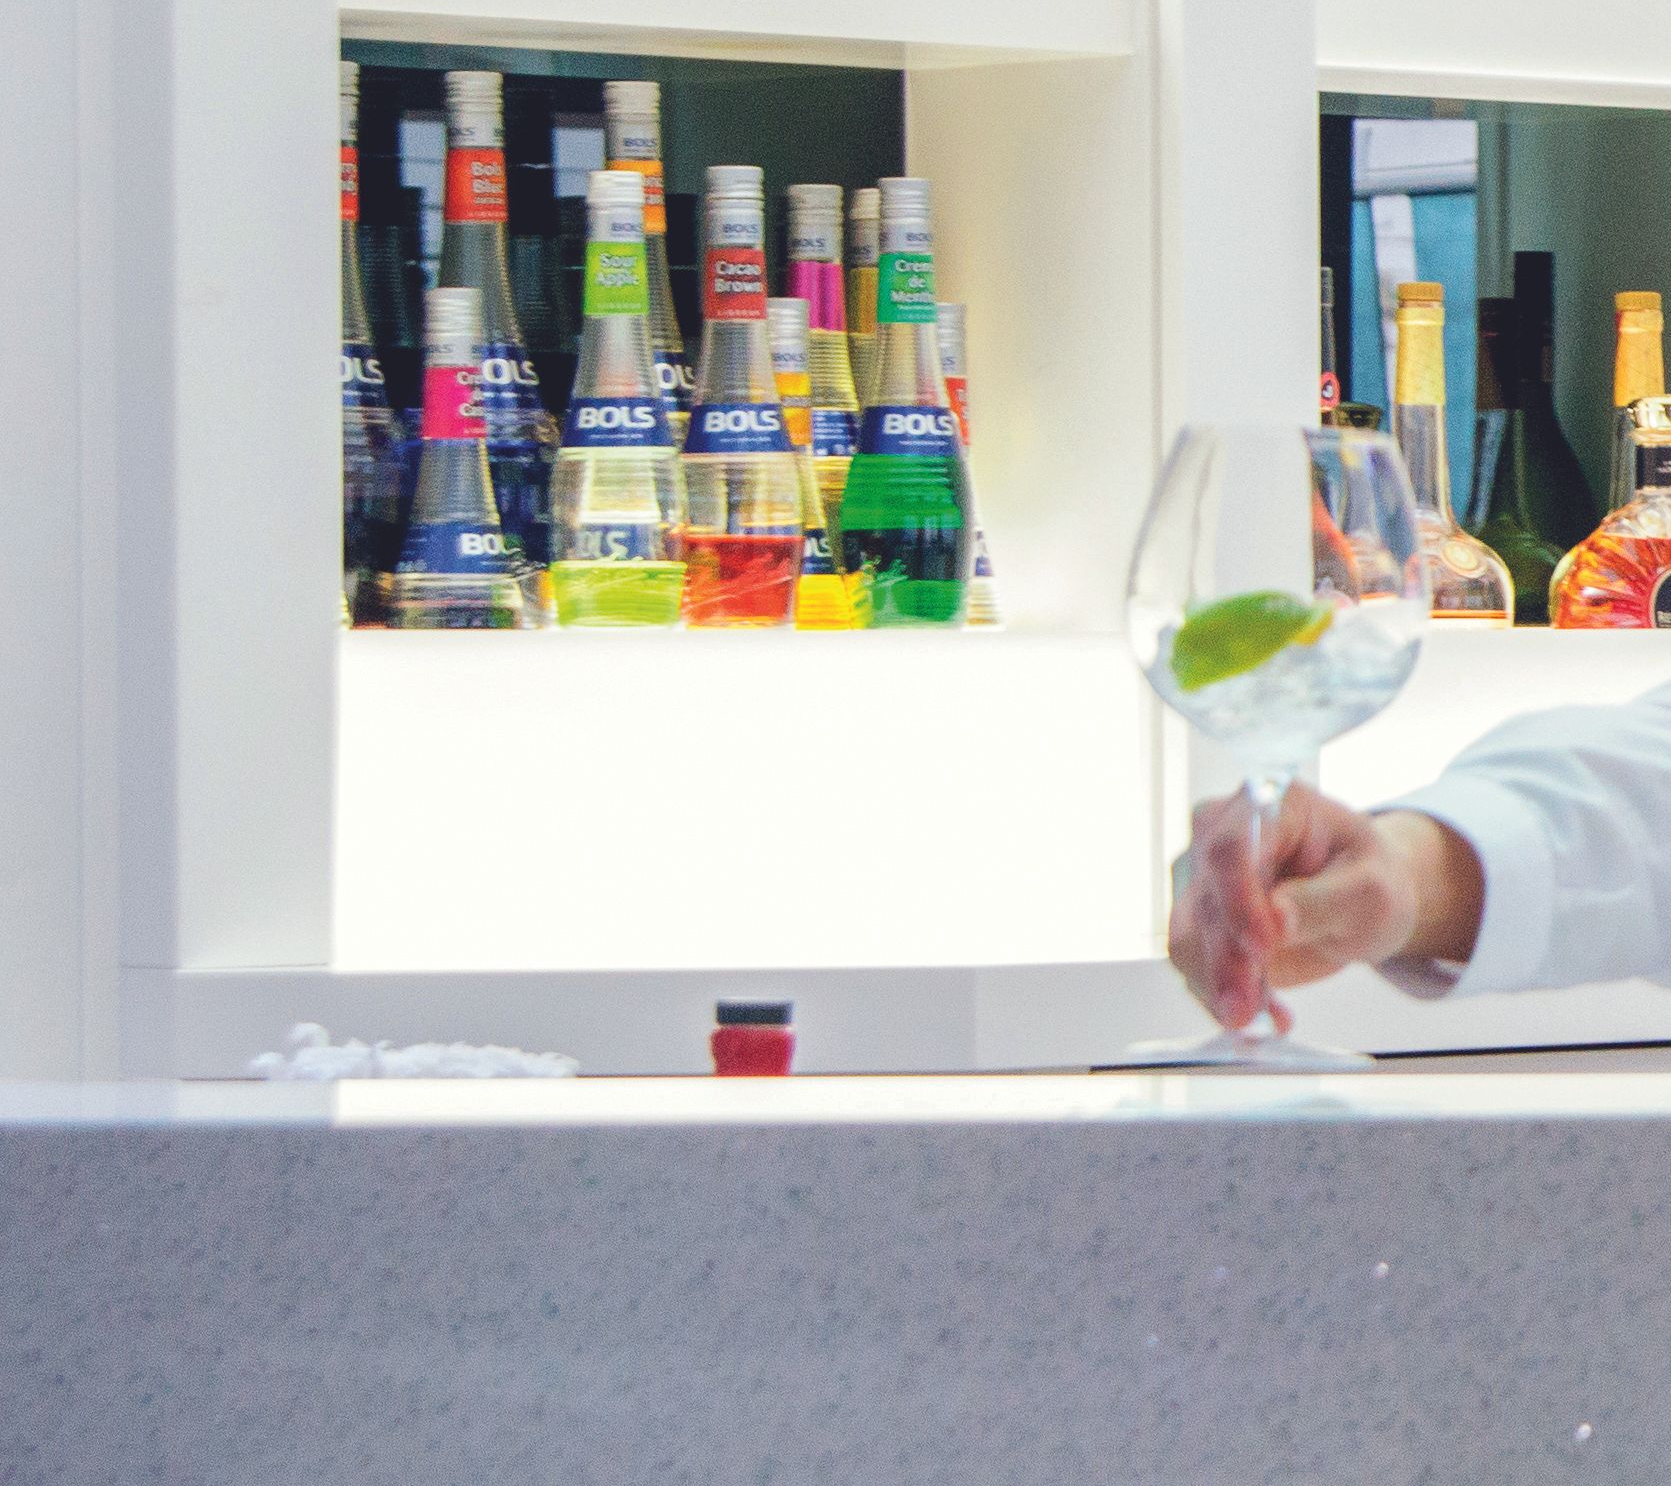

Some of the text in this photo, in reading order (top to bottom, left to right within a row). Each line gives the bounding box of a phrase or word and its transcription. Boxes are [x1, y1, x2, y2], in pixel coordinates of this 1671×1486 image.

[482, 358, 539, 385] OLS
[577, 406, 656, 429] BOLS
[704, 410, 780, 432] BOLS
[882, 413, 955, 435] BOLS
